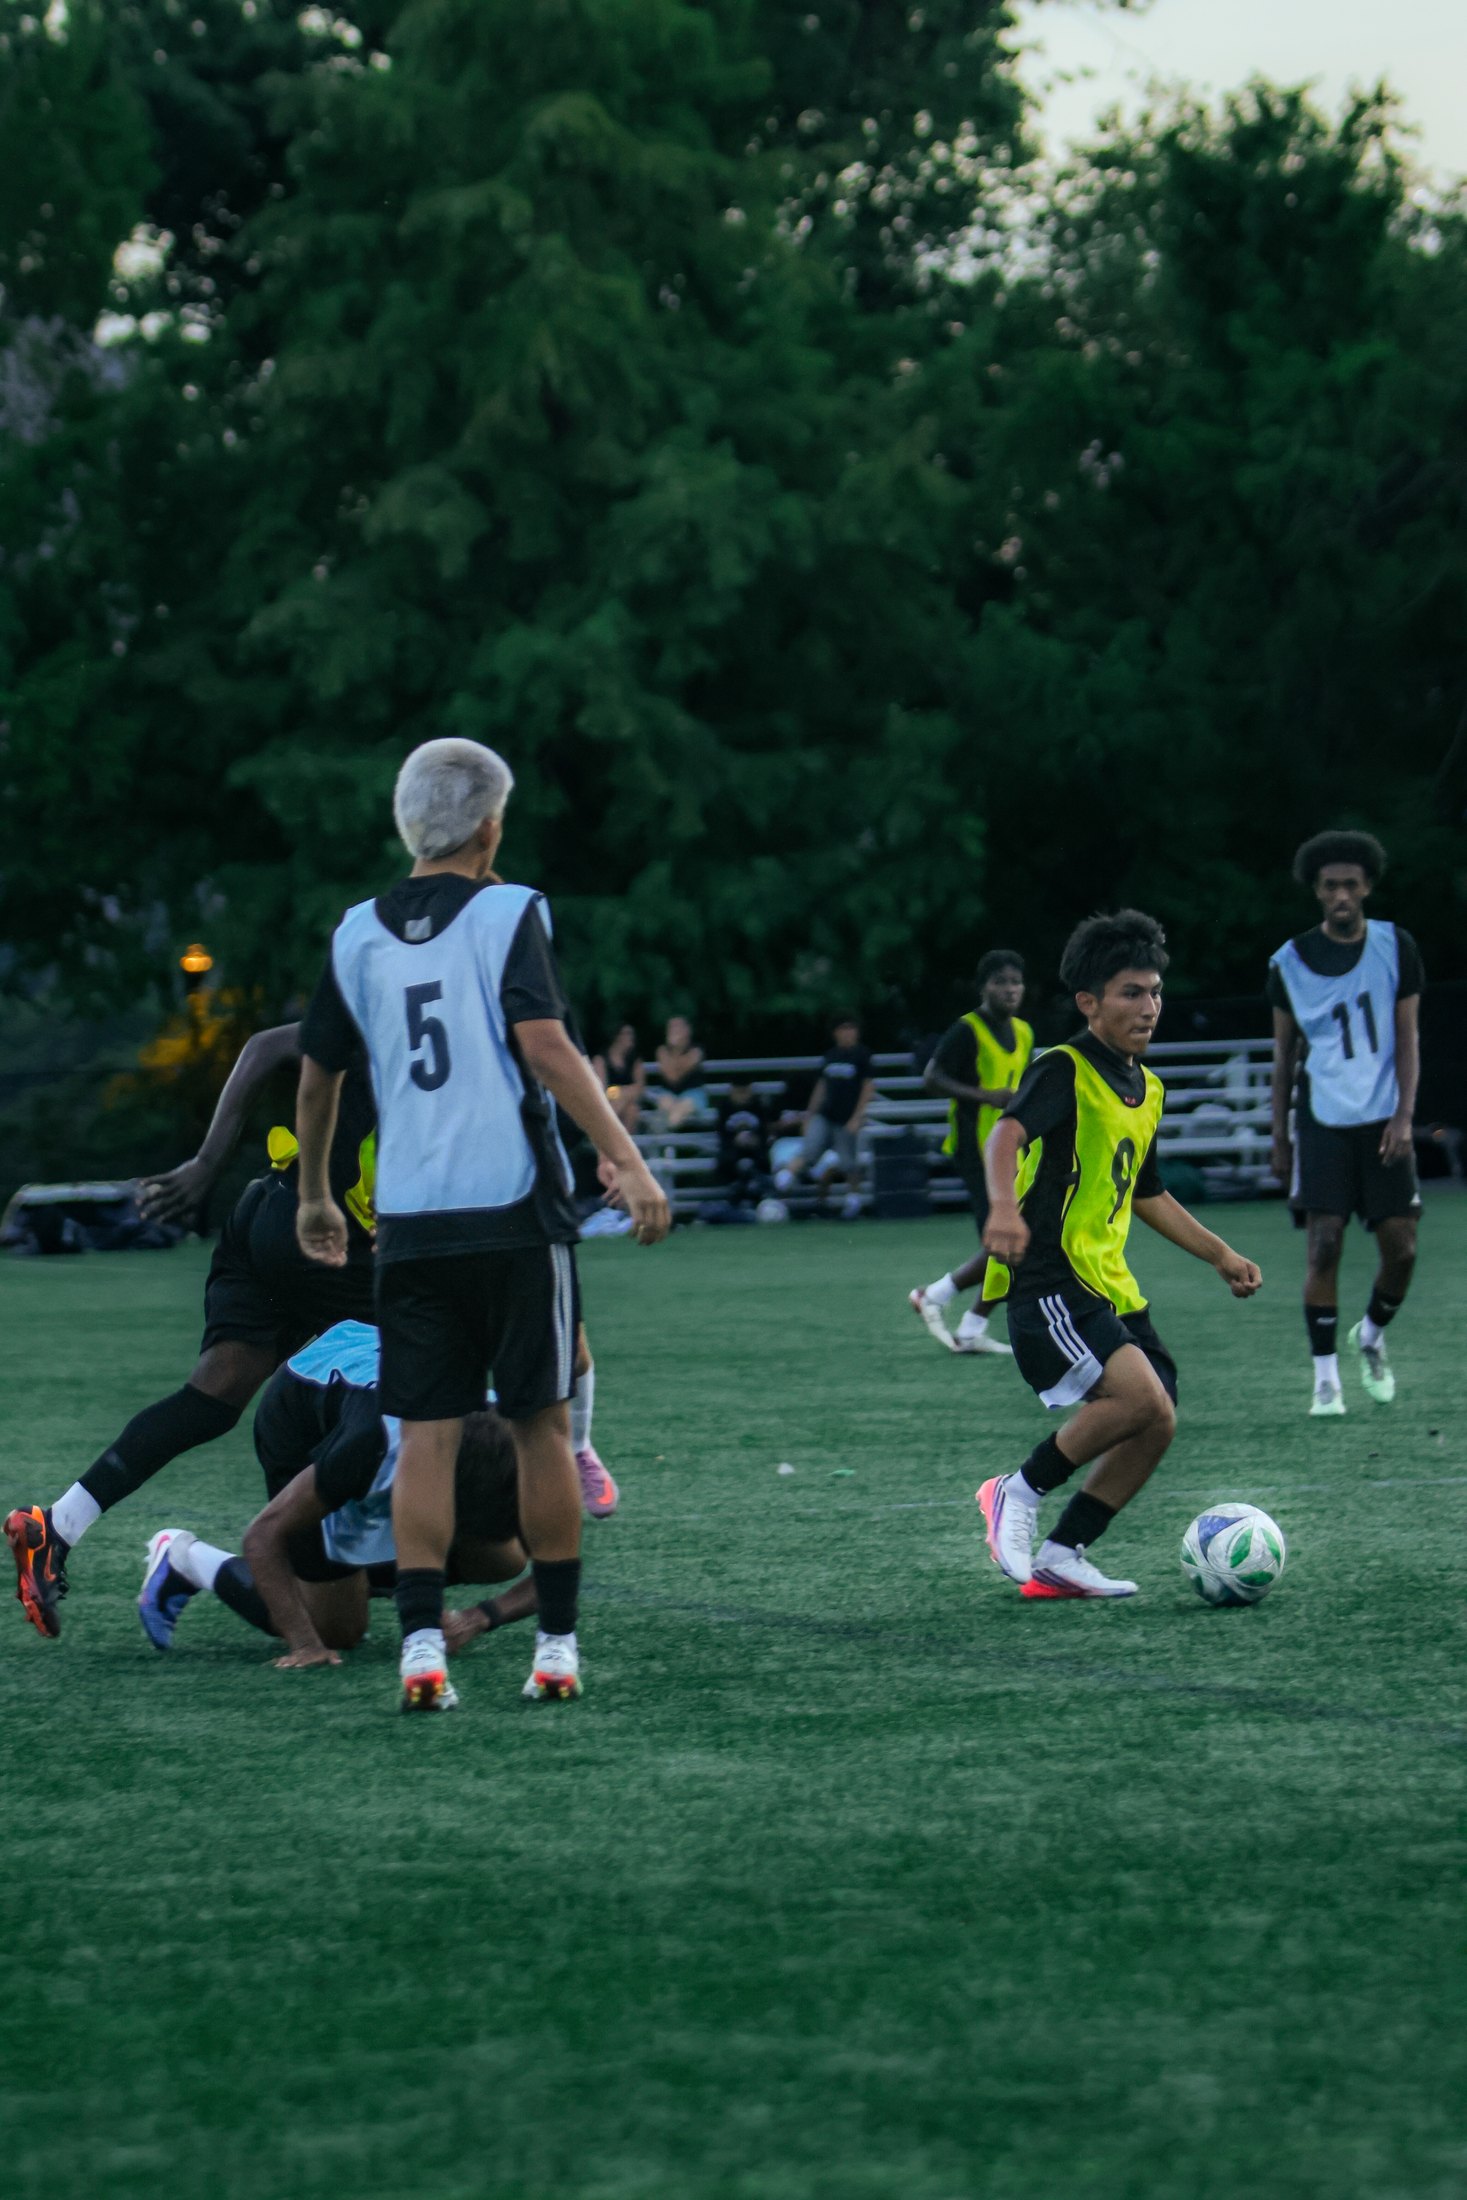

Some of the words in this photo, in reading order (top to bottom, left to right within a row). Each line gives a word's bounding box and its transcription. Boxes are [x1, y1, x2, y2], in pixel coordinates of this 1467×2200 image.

[404, 980, 450, 1091] 5
[1331, 991, 1378, 1059] 11
[1107, 1137, 1134, 1224] 9
